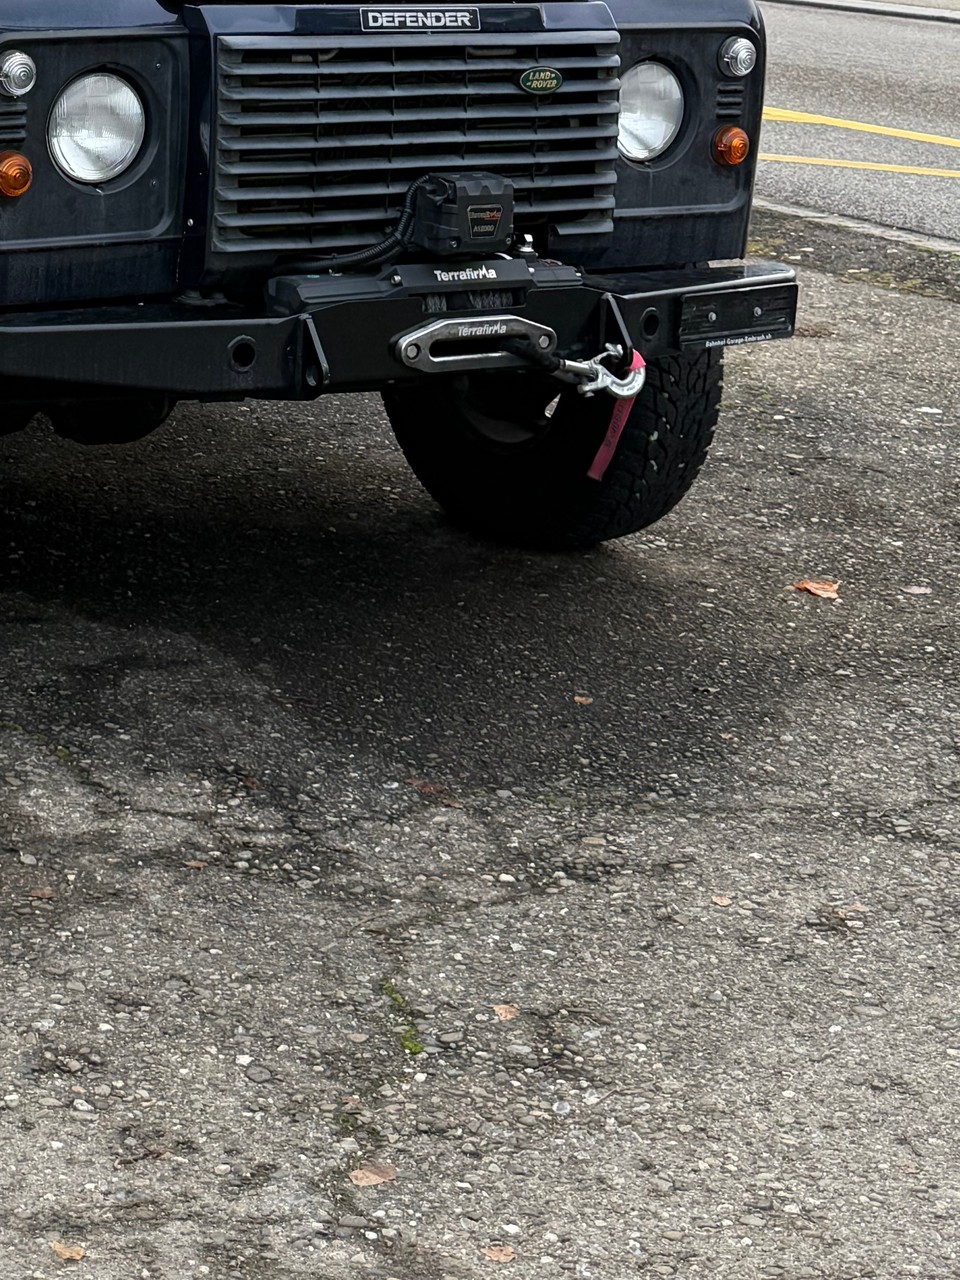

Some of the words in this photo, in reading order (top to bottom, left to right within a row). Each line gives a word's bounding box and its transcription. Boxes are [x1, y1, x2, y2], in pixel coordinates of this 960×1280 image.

[367, 11, 472, 27] DEFENDER
[529, 71, 551, 80] LAND
[530, 79, 558, 88] ROVER
